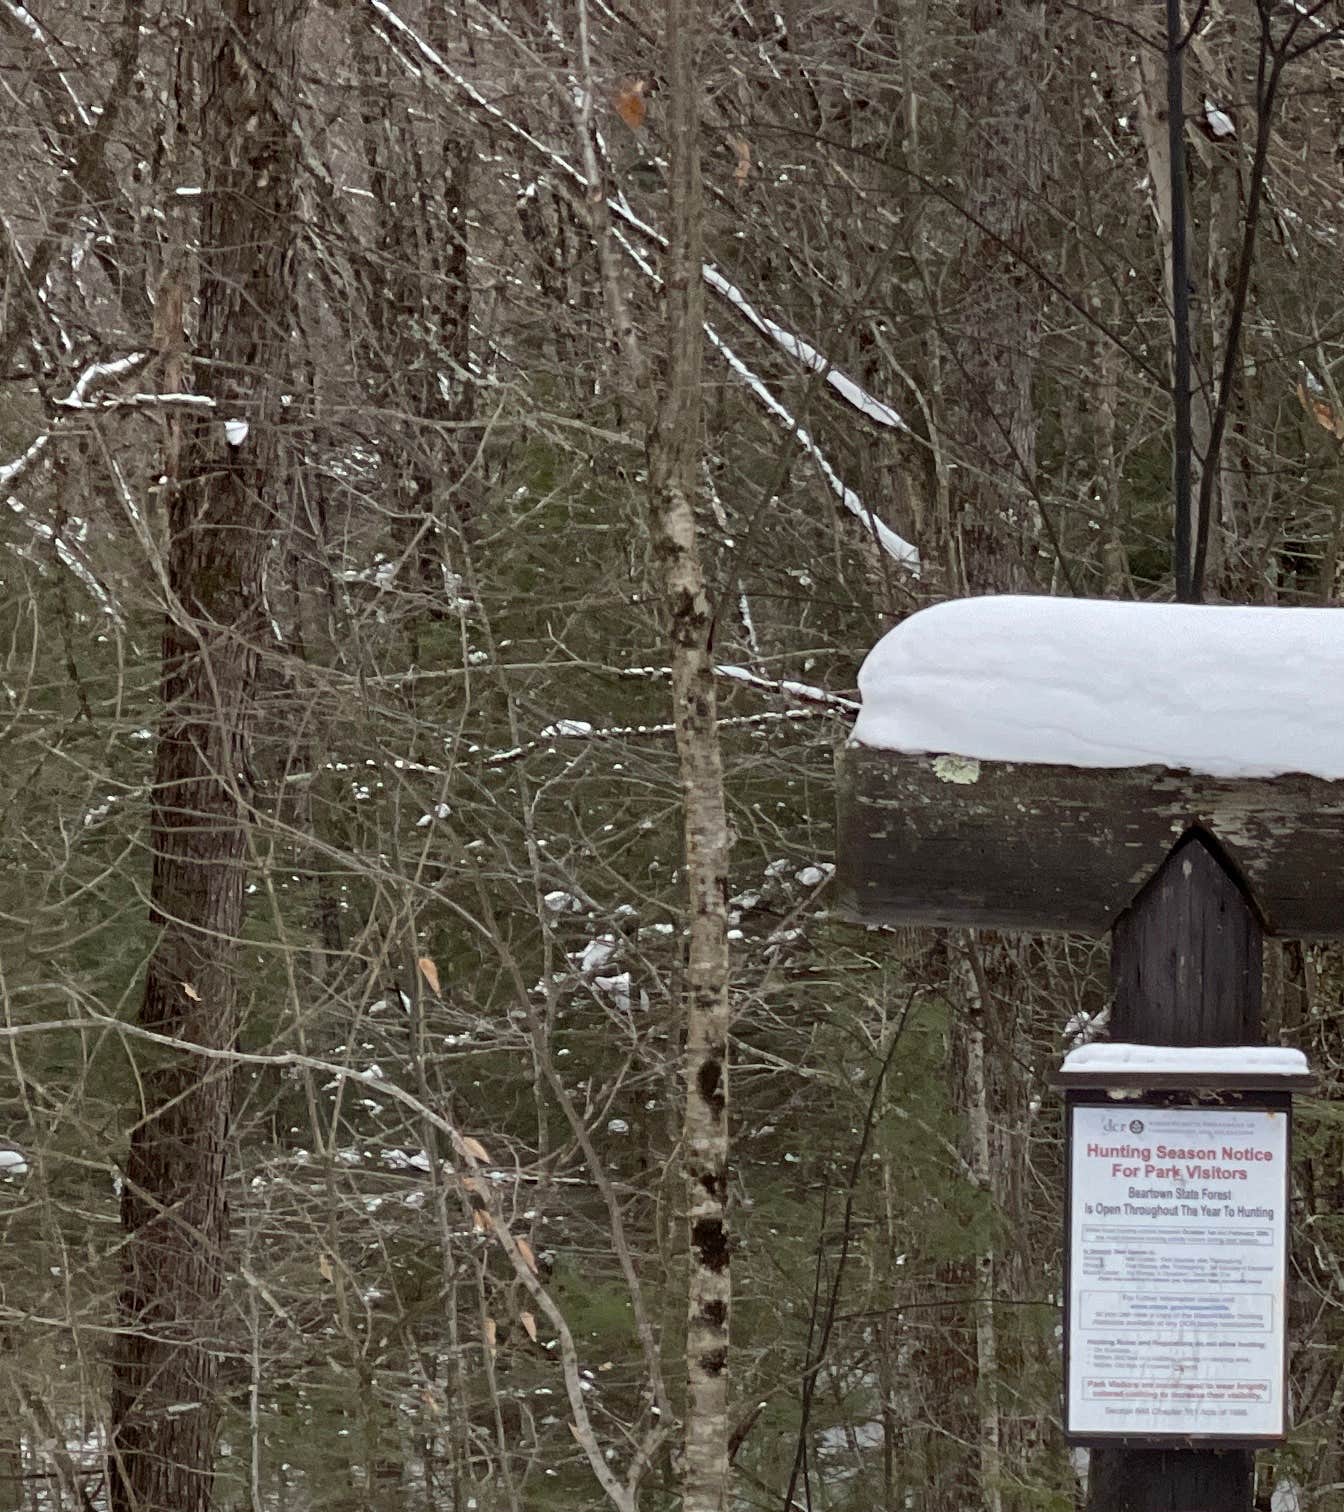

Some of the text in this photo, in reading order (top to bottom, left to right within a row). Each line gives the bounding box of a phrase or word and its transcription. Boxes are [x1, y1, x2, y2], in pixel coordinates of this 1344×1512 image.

[1087, 1144, 1273, 1162] Hunting Season Notice
[1112, 1163, 1248, 1180] For Park Visitors
[1128, 1186, 1232, 1201] Beartown State Forest
[1085, 1203, 1274, 1221] Is Open Throughout The Year To Hunting
